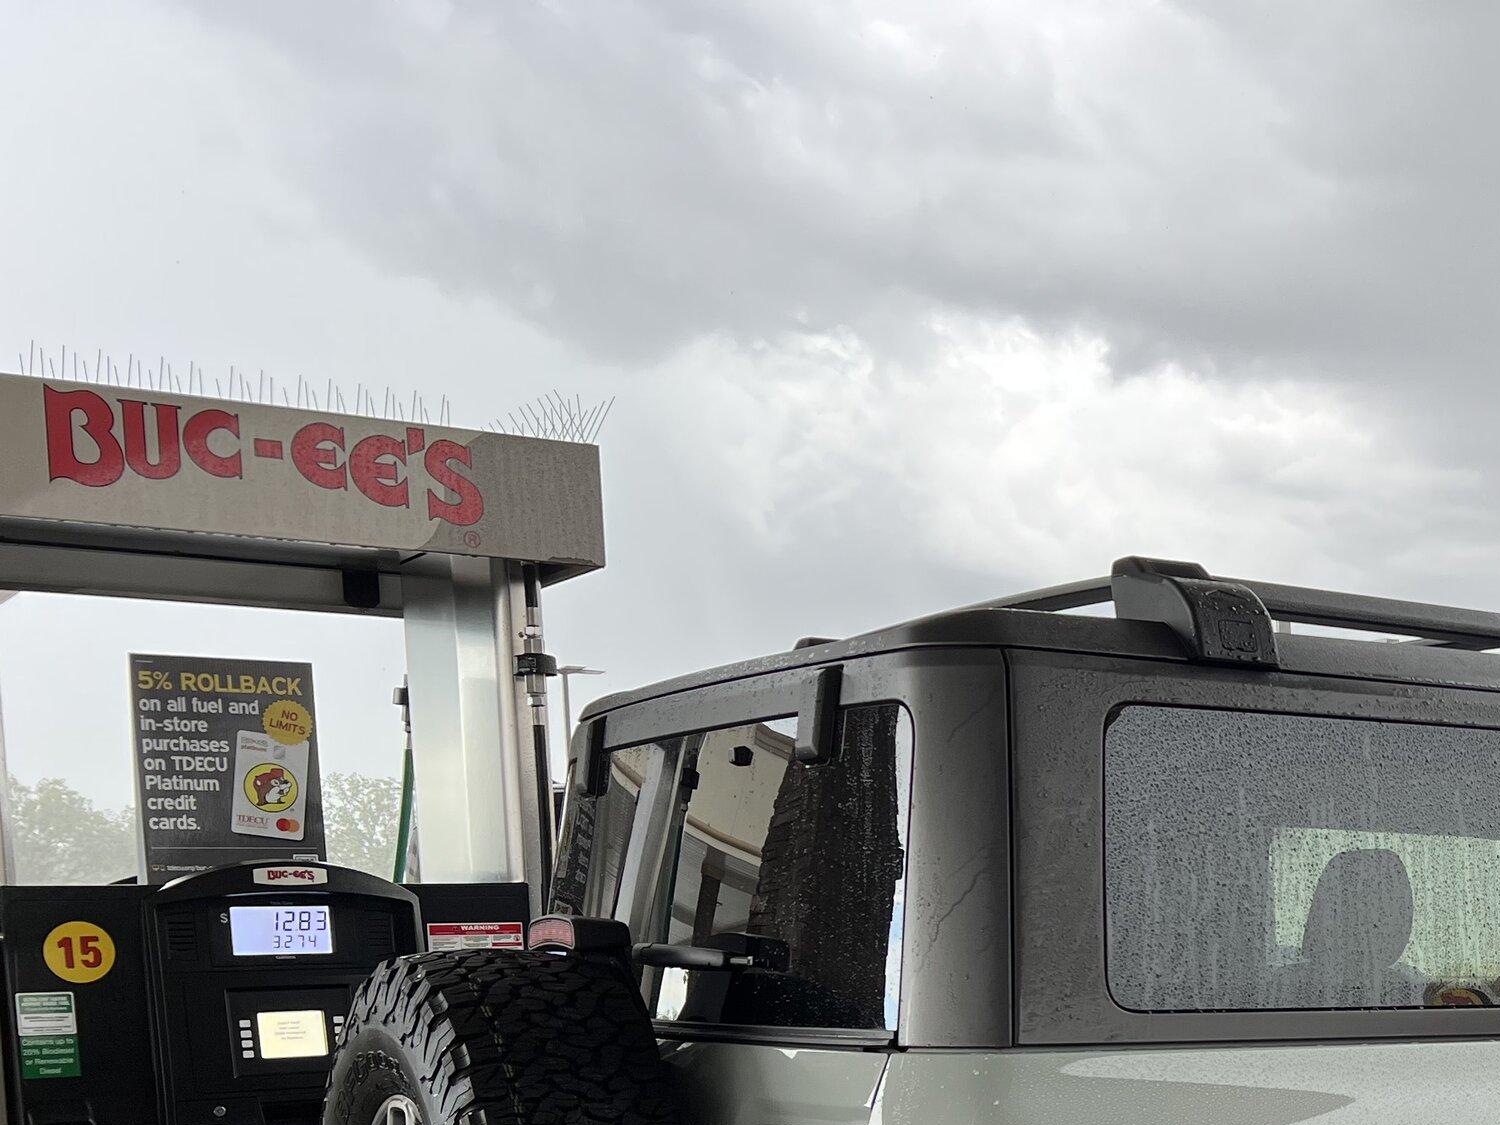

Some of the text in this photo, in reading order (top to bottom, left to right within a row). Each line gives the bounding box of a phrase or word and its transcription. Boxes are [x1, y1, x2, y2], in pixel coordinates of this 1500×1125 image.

[137, 670, 304, 696] 5% ROLLBACK
[138, 697, 260, 715] on all fuel and
[281, 709, 298, 720] NO
[139, 715, 209, 733] in-store
[268, 718, 306, 735] LIMITS
[141, 736, 230, 754] purchases
[143, 756, 229, 772] on TDECU
[145, 775, 220, 792] Platinum
[147, 794, 198, 811] credit
[148, 814, 201, 831] cards.
[236, 814, 270, 826] TDECU
[459, 924, 501, 932] WARNING
[56, 936, 103, 970] 15
